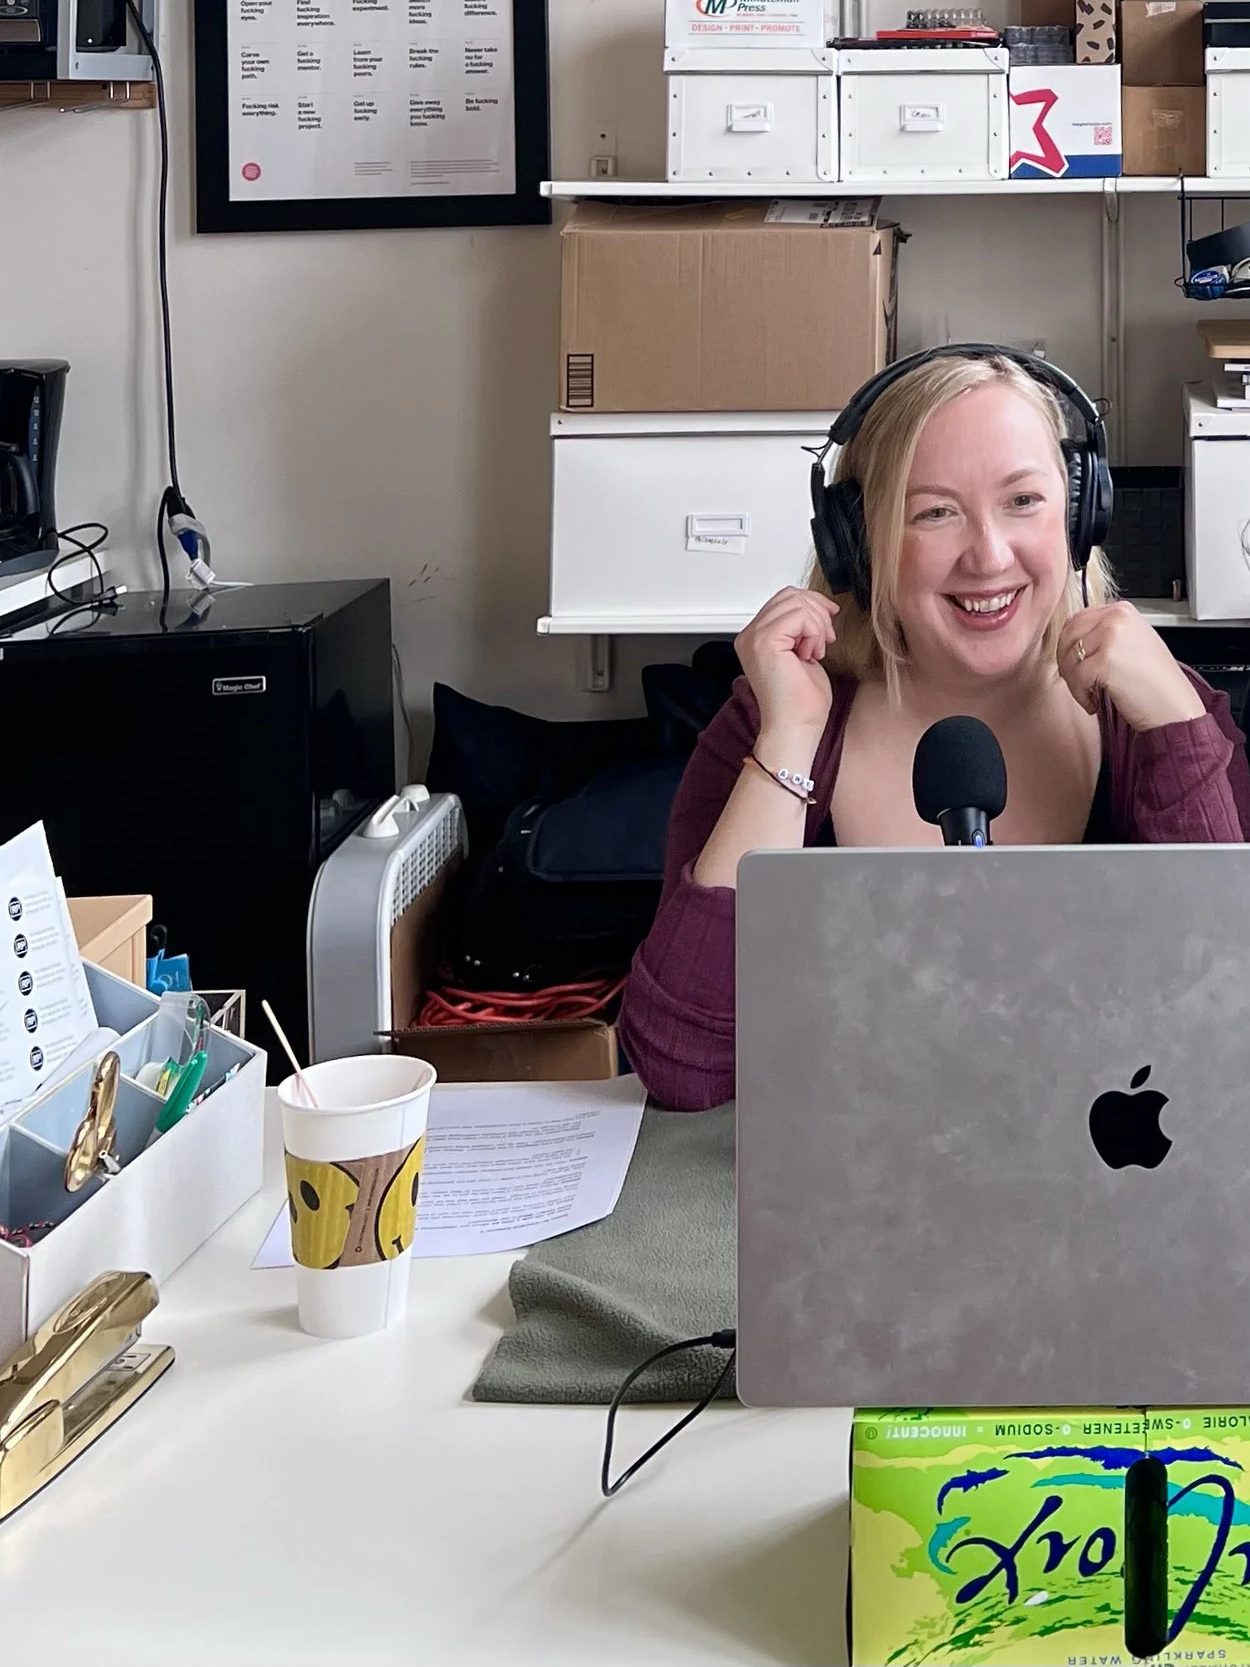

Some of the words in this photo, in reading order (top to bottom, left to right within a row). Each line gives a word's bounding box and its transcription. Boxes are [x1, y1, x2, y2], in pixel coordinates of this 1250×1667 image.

[737, 3, 766, 12] Press
[886, 1425, 967, 1438] INNOCENT!
[995, 1423, 1071, 1436] 0-SODIUM
[1067, 1656, 1121, 1666] WATER
